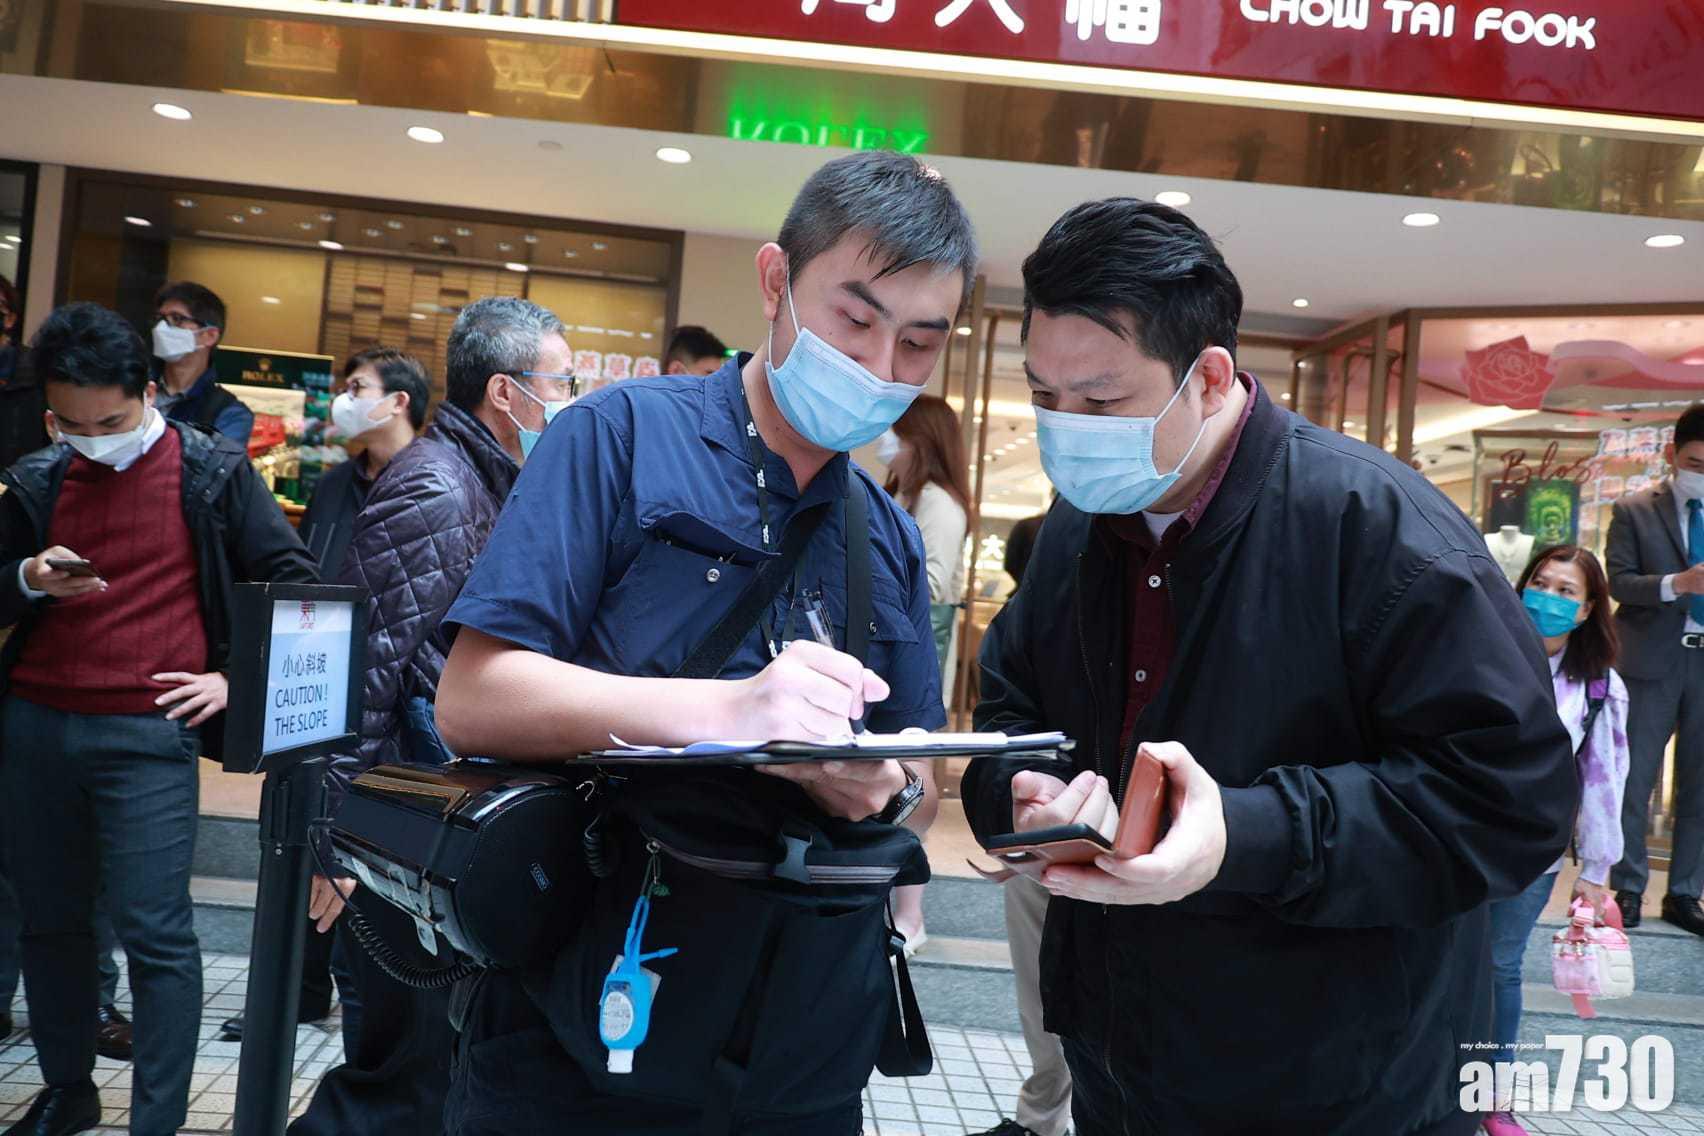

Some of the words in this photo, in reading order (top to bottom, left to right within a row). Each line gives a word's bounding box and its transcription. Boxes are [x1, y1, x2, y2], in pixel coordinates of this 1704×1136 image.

[1239, 0, 1368, 30] CHOW
[1383, 0, 1454, 37] TAI
[1474, 8, 1596, 50] FOOK
[282, 652, 327, 678] 小心斜坡
[275, 714, 296, 736] THE
[298, 709, 328, 732] SLOPE
